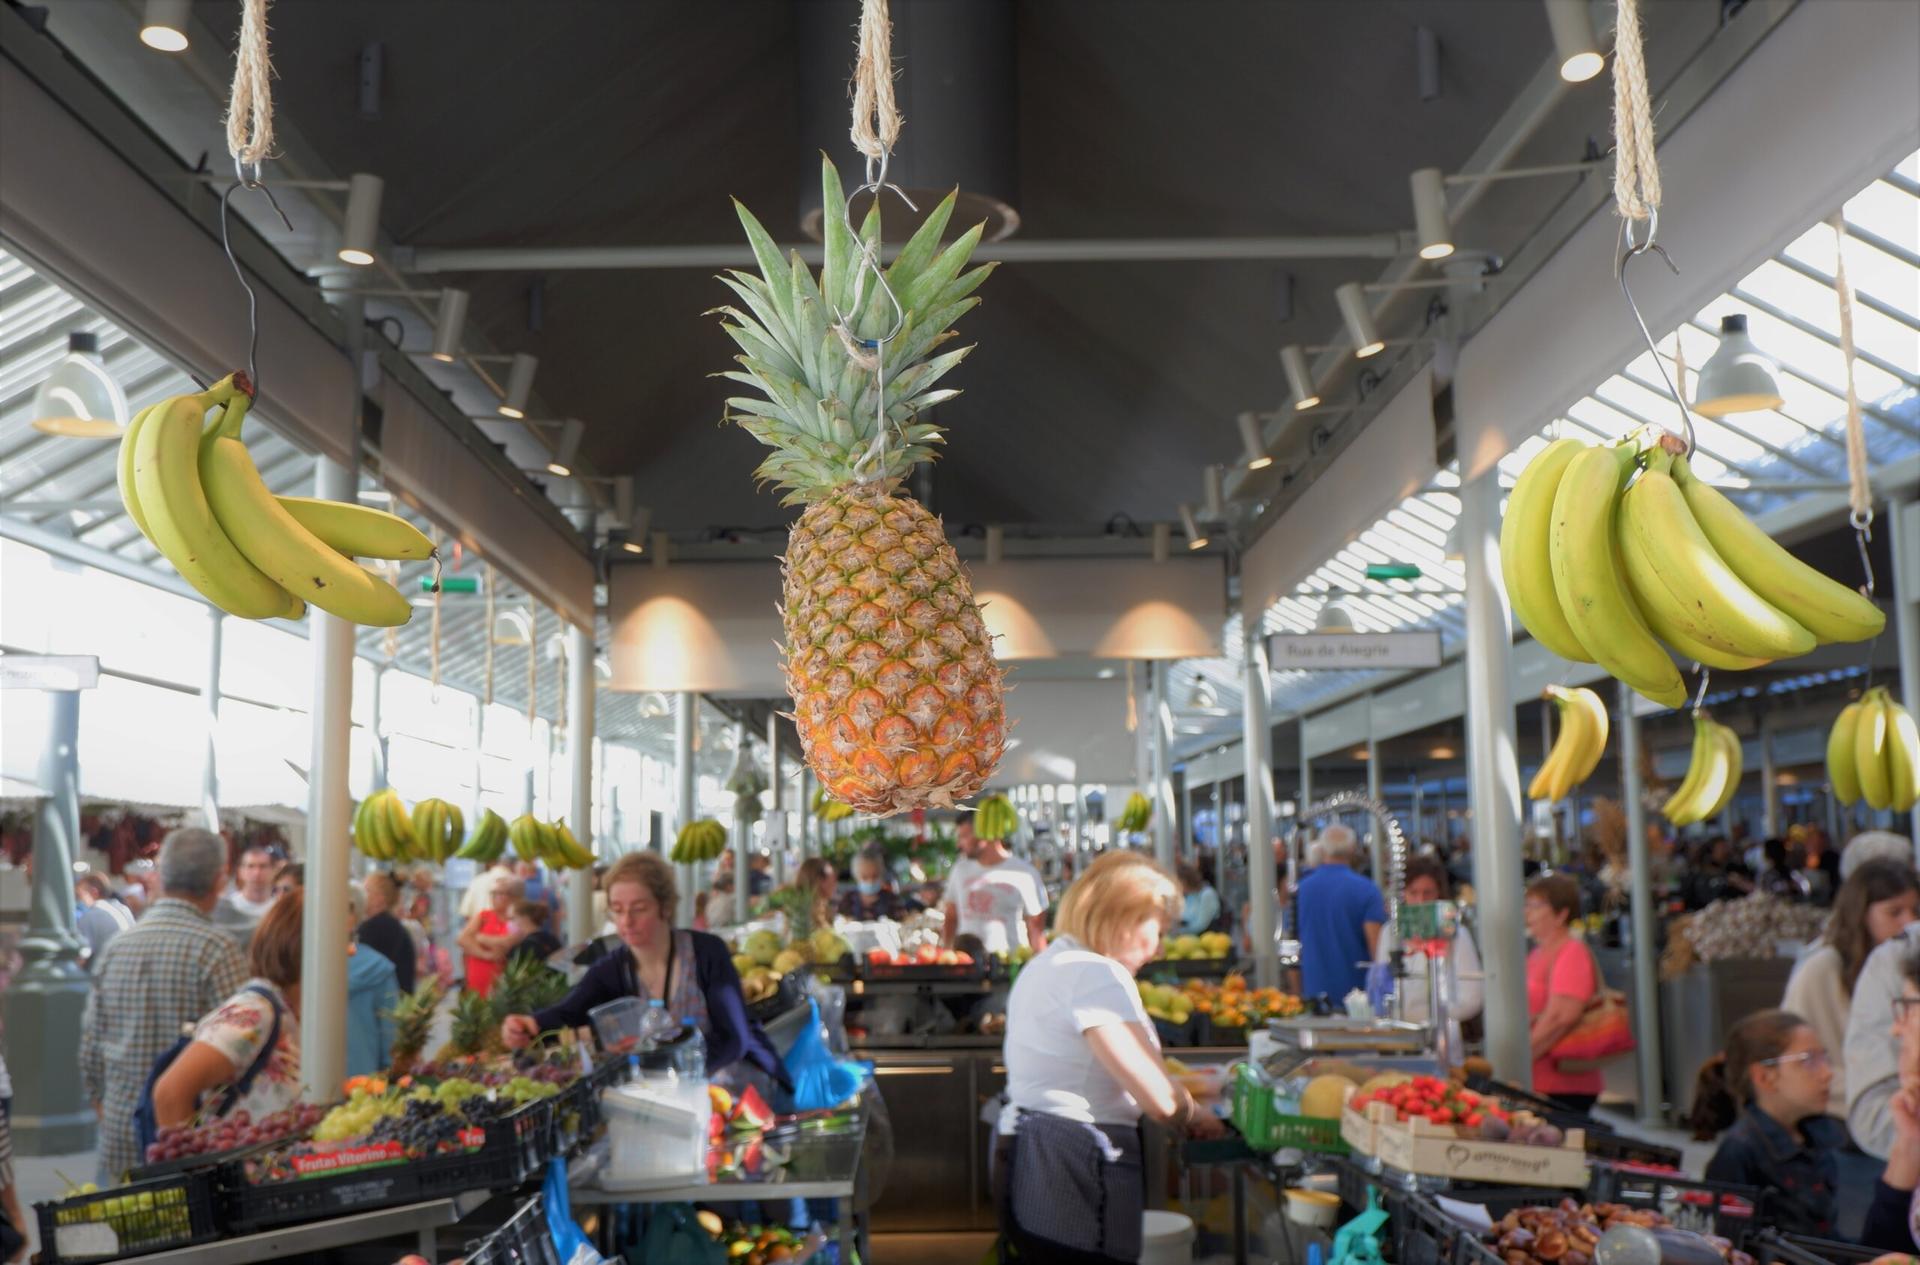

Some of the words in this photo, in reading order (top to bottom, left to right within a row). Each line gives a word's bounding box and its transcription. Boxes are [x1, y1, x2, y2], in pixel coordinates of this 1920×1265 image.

[1287, 643, 1314, 657] Rua
[1339, 642, 1390, 659] Alegria
[298, 1156, 337, 1171] Frutas
[337, 1149, 387, 1166] Vitorino
